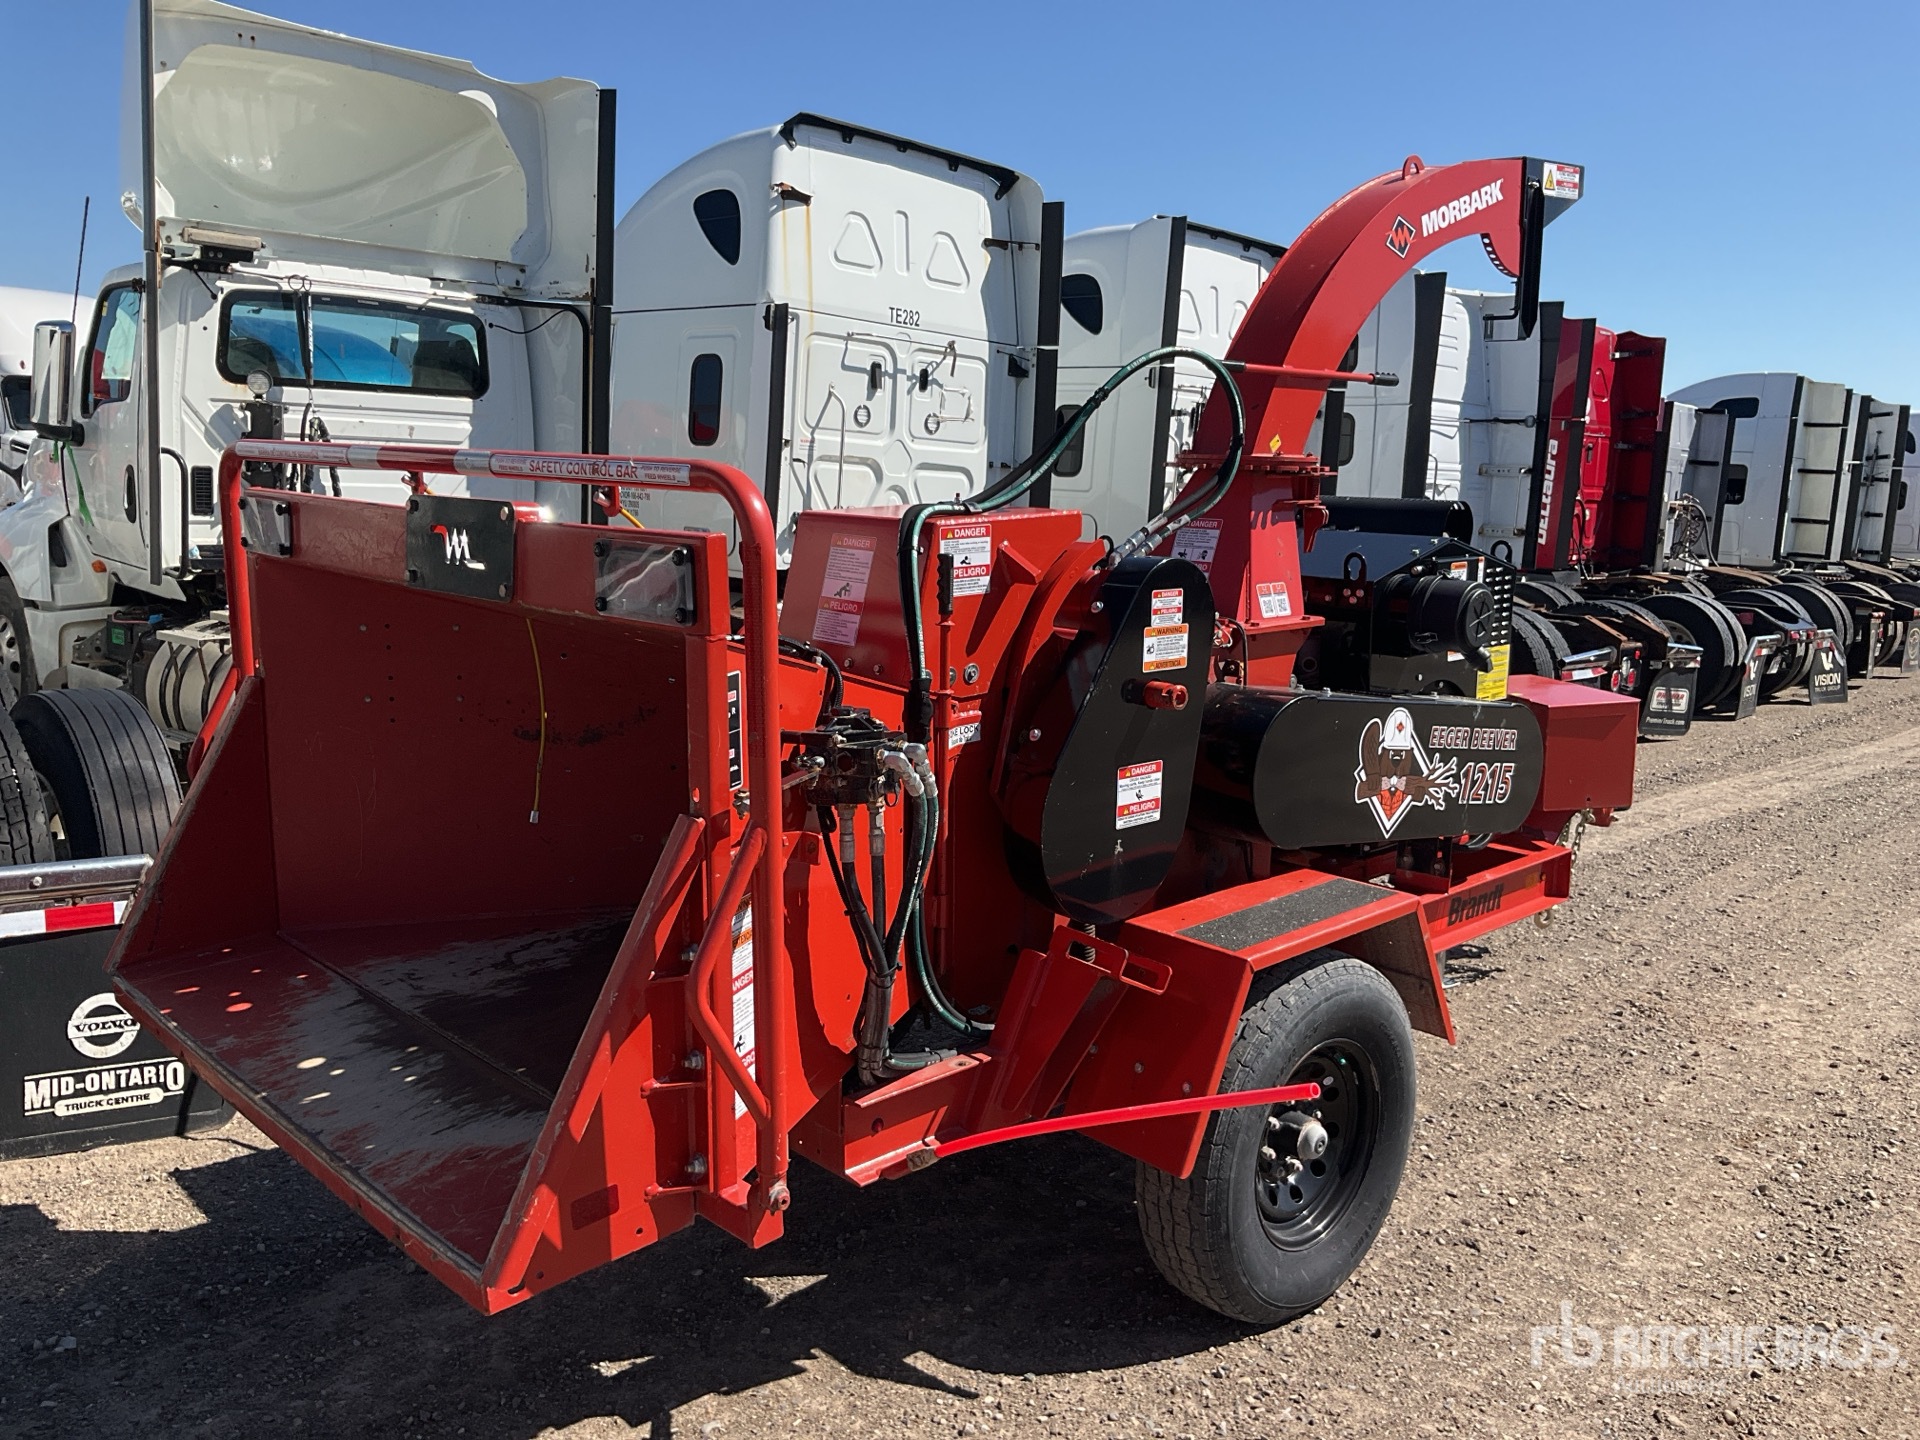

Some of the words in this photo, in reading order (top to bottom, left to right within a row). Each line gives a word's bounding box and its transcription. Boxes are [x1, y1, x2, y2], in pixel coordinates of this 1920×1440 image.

[1421, 180, 1504, 238] MORBARK
[888, 306, 921, 328] TE282
[529, 460, 564, 474] SAFETY
[566, 461, 613, 477] CONTROL
[616, 465, 638, 479] BAR
[1191, 520, 1218, 528] DANGER
[954, 527, 986, 538] DANGER
[843, 538, 871, 548] DANGER
[953, 567, 987, 578] PELIGRO
[830, 601, 858, 612] PELIGRO
[1157, 626, 1183, 635] WARNING
[1814, 672, 1841, 686] VISION
[960, 724, 979, 735] LOCK
[1429, 726, 1469, 749] EEGER
[1470, 728, 1518, 750] BEEVER
[1131, 764, 1157, 776] DANGER
[1458, 762, 1515, 804] 1215
[1129, 801, 1156, 813] PELIGRO
[1447, 882, 1505, 927] Brandt
[74, 1017, 138, 1034] VOLVO
[24, 1061, 185, 1111] MID-ONTARIO
[65, 1099, 104, 1112] TRUCK
[106, 1093, 151, 1106] CENTRE
